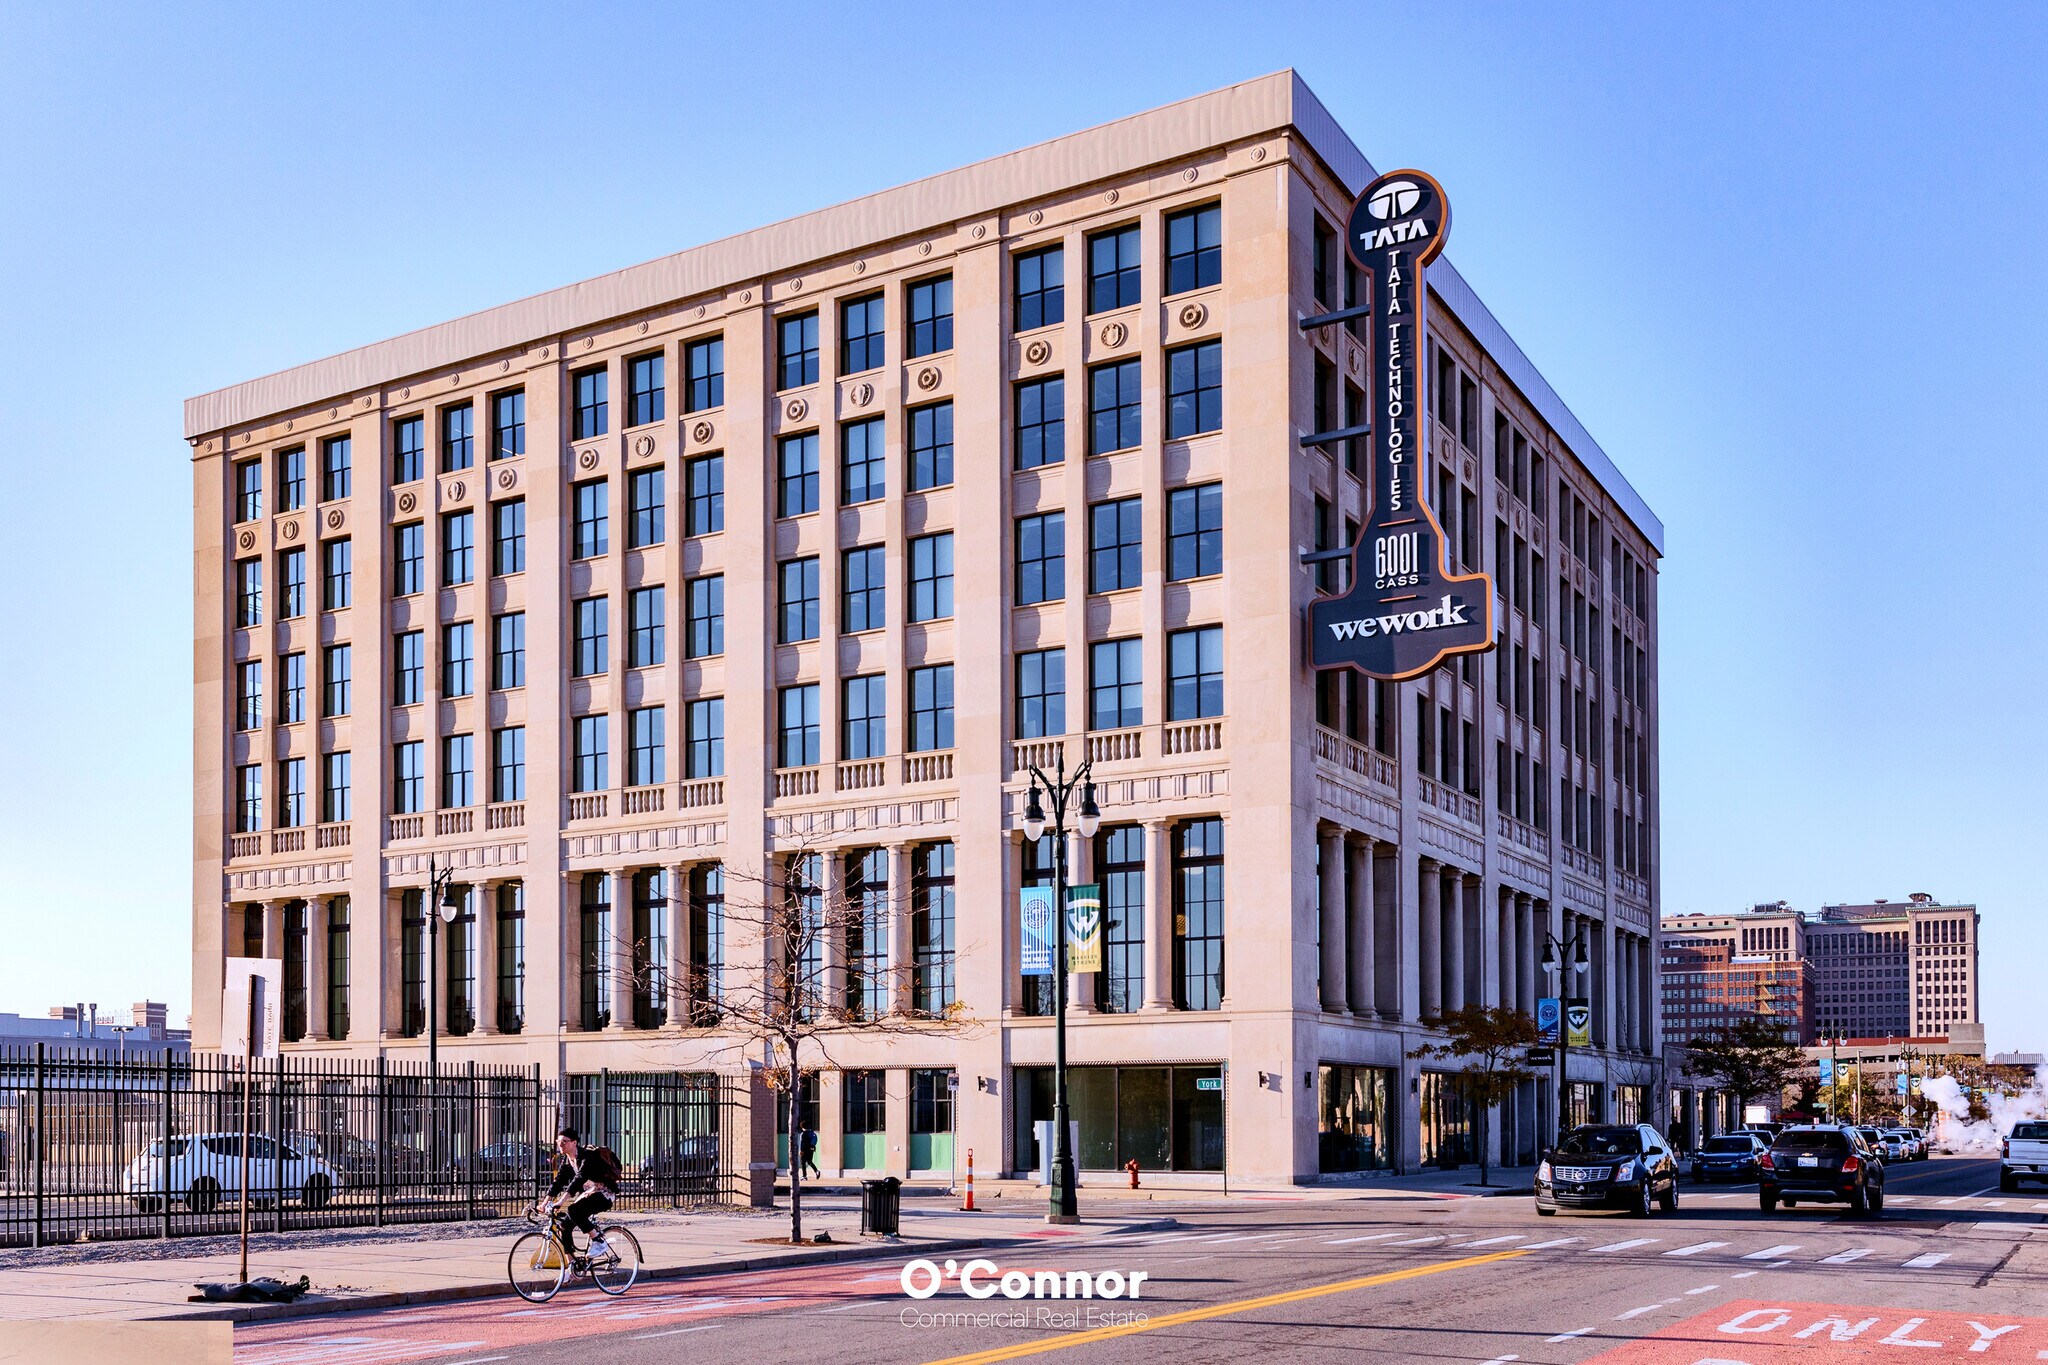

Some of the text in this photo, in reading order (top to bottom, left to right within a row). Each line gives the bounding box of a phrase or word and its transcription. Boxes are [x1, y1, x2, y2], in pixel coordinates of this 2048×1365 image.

[1360, 218, 1428, 250] TATA
[1388, 250, 1403, 511] TATA TECHNOLOGIES
[1375, 532, 1418, 578] 6001
[1375, 574, 1419, 589] CASS
[1329, 594, 1468, 641] wework
[1201, 1080, 1217, 1088] York
[1716, 1308, 2022, 1352] ONLY
